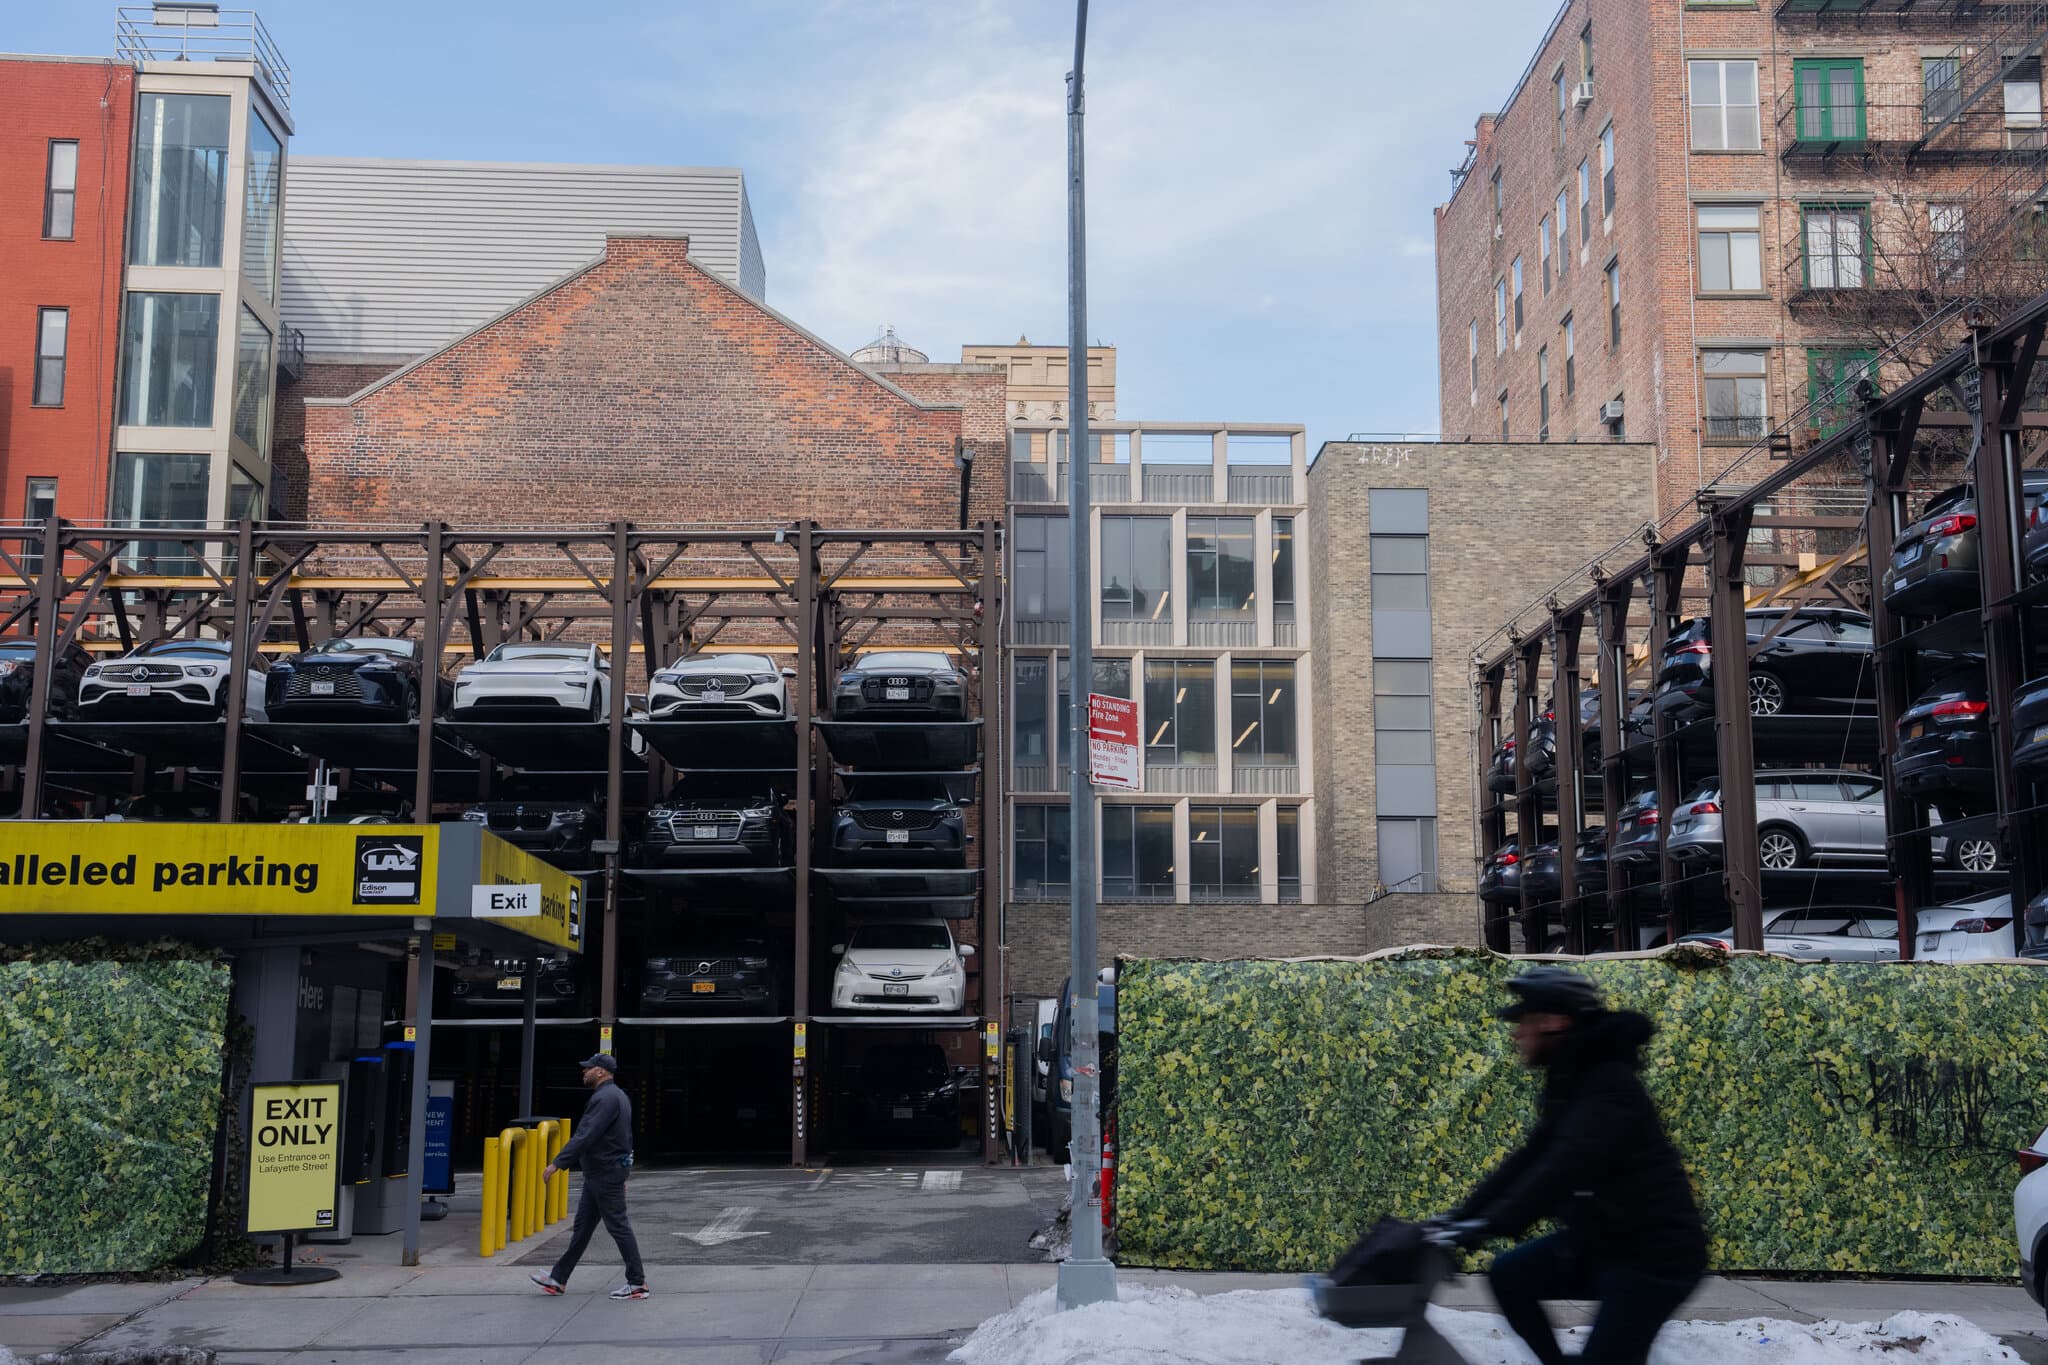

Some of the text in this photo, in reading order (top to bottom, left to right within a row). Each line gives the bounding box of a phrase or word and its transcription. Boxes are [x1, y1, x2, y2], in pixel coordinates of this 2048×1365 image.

[1092, 699, 1130, 713] NO STANDING
[1092, 710, 1119, 722] Fire Zone
[1092, 742, 1128, 756] NO PARKING
[367, 854, 416, 871] LAZ
[153, 855, 319, 893] parking
[491, 893, 528, 910] Exit
[541, 892, 566, 928] parking
[298, 976, 324, 1009] Here
[266, 1098, 328, 1121] EXIT
[426, 1111, 446, 1119] NEW
[258, 1124, 333, 1147] ONLY
[258, 1153, 331, 1163] Use Entrance on
[259, 1162, 328, 1174] Lafayette Street
